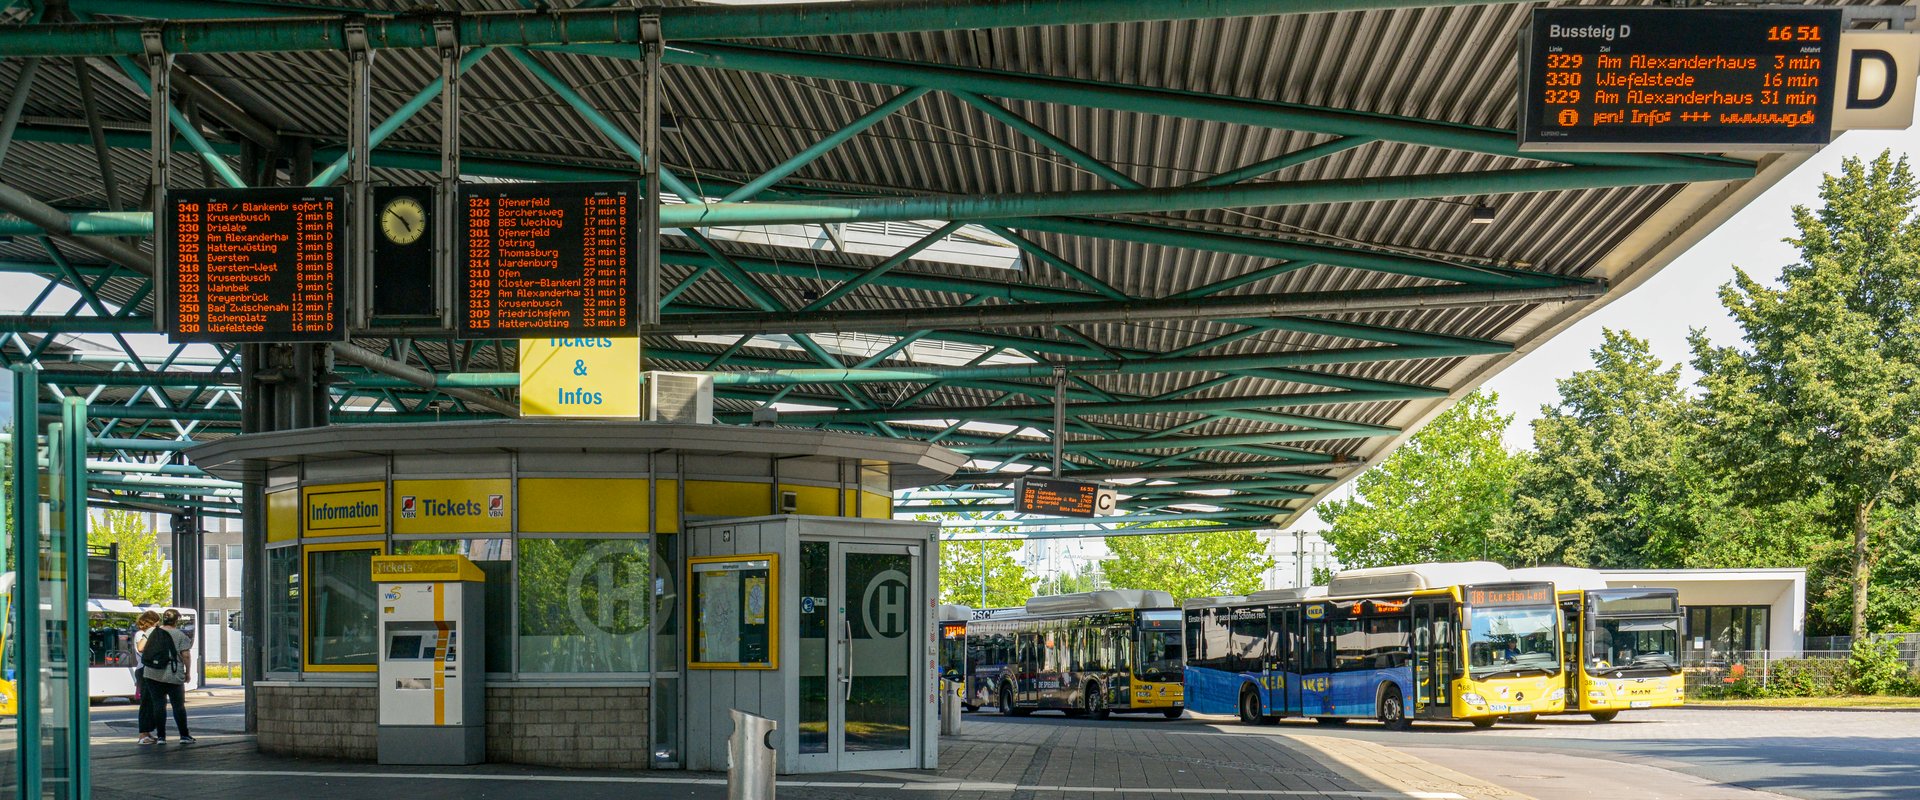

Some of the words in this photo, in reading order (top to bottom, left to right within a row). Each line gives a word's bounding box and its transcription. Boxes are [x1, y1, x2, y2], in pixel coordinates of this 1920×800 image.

[1550, 24, 1616, 40] Bussteig
[1620, 25, 1631, 38] D
[1768, 26, 1792, 40] 16
[1796, 26, 1821, 40] 51
[1547, 54, 1584, 69] 329
[1597, 54, 1622, 69] Am
[1629, 54, 1757, 70] Alexanderhaus
[1773, 55, 1785, 70] 3
[1788, 55, 1820, 70] min
[1546, 72, 1582, 86] 330
[1596, 72, 1695, 90] Wiefelstede
[1763, 73, 1782, 87] 16
[1787, 73, 1819, 87] min
[1846, 48, 1898, 110] D
[1544, 90, 1580, 104] 329
[1594, 90, 1619, 104] Am
[1627, 90, 1754, 105] Alexanderhaus
[1760, 90, 1780, 105] 31
[1785, 90, 1818, 105] min
[179, 204, 200, 212] 340
[208, 203, 228, 212] IKEA
[292, 203, 323, 212] sofort
[469, 199, 490, 207] 324
[499, 198, 549, 208] Ofenerfeld
[584, 197, 595, 206] 16
[598, 197, 616, 206] min
[179, 214, 200, 222] 313
[208, 213, 270, 222] Krusenbusch
[306, 213, 323, 221] min
[469, 209, 490, 217] 302
[499, 208, 563, 218] Borchersweg
[584, 207, 595, 216] 17
[598, 208, 616, 216] min
[179, 224, 200, 232] 330
[208, 223, 247, 232] Drielake
[306, 223, 323, 231] min
[469, 219, 490, 227] 308
[499, 218, 516, 227] BBS
[521, 218, 562, 228] Wechloy
[584, 217, 595, 226] 17
[598, 218, 616, 226] min
[179, 234, 200, 242] 329
[208, 233, 222, 242] Am
[306, 233, 323, 241] min
[469, 229, 490, 238] 301
[499, 228, 549, 238] Ofenerfeld
[584, 228, 595, 236] 23
[598, 228, 616, 236] min
[179, 244, 200, 253] 325
[208, 243, 277, 253] Hatterwüsting
[306, 243, 323, 251] min
[469, 239, 490, 248] 322
[499, 238, 535, 248] Ostring
[584, 238, 595, 246] 23
[598, 238, 616, 246] min
[179, 254, 200, 263] 301
[208, 253, 249, 262] Eversten
[306, 253, 323, 261] min
[469, 249, 490, 258] 322
[500, 248, 558, 258] Thomasburg
[584, 248, 595, 256] 23
[598, 248, 616, 256] min
[179, 264, 200, 273] 318
[208, 264, 277, 272] Eversten-West
[306, 263, 323, 271] min
[469, 259, 490, 268] 314
[499, 259, 558, 268] Wardenburg
[584, 258, 595, 266] 25
[598, 258, 616, 266] min
[179, 274, 200, 283] 323
[208, 274, 270, 282] Krusenbusch
[306, 273, 323, 281] min
[469, 269, 490, 278] 310
[499, 269, 520, 278] Ofen
[584, 268, 595, 276] 27
[598, 268, 616, 276] min
[179, 284, 200, 293] 323
[208, 284, 249, 292] Wahnbek
[306, 283, 323, 291] min
[469, 280, 490, 288] 340
[584, 278, 595, 286] 28
[598, 278, 616, 286] min
[179, 294, 200, 303] 321
[208, 294, 268, 303] Kreyenbrück
[292, 293, 302, 301] 11
[306, 293, 323, 301] min
[469, 290, 490, 298] 329
[499, 289, 512, 297] Am
[584, 288, 595, 296] 31
[598, 288, 616, 296] min
[179, 304, 200, 313] 350
[208, 304, 226, 312] Bad
[292, 303, 303, 311] 12
[306, 303, 323, 311] min
[469, 300, 490, 308] 313
[499, 299, 562, 307] Krusenbusch
[584, 298, 595, 306] 32
[598, 298, 616, 306] min
[179, 314, 200, 323] 309
[208, 314, 266, 323] Eschenplatz
[292, 313, 303, 321] 13
[306, 313, 323, 321] min
[469, 310, 490, 318] 309
[499, 309, 570, 319] Friedrichsfehn
[584, 308, 595, 317] 33
[598, 308, 616, 317] min
[179, 324, 200, 333] 330
[208, 324, 264, 333] Wiefelstede
[292, 323, 303, 331] 16
[306, 323, 323, 332] min
[469, 320, 490, 328] 315
[499, 319, 569, 329] Hatterwüsting
[584, 318, 595, 327] 33
[598, 318, 616, 327] min
[573, 359, 587, 376] &
[558, 387, 603, 405] Infos
[1098, 494, 1111, 510] C
[312, 501, 378, 520] Information
[422, 499, 481, 516] Tickets
[376, 562, 413, 574] Tickets
[598, 562, 644, 627] H
[879, 586, 905, 633] H
